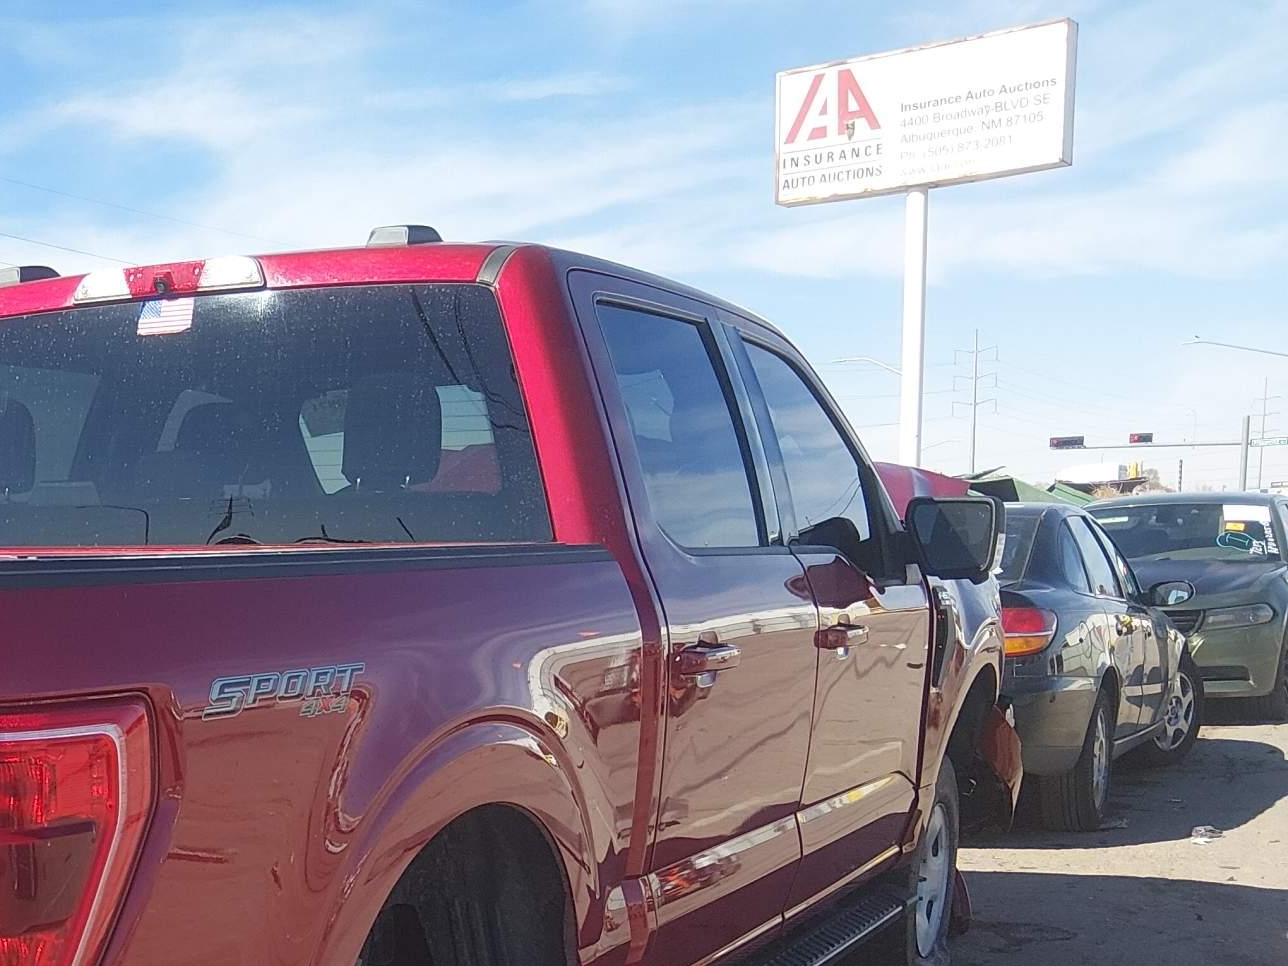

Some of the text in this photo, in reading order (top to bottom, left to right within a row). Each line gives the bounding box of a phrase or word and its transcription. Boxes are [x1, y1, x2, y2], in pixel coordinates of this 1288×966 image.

[899, 114, 929, 128] 4400
[1033, 93, 1051, 106] SE
[900, 78, 1057, 113] Insurance Auto Auctions
[981, 118, 1002, 131] NM
[783, 144, 883, 169] INSURANCE
[782, 175, 815, 191] AUTO
[820, 166, 882, 184] AUCTIONS
[202, 662, 365, 721] SPORT
